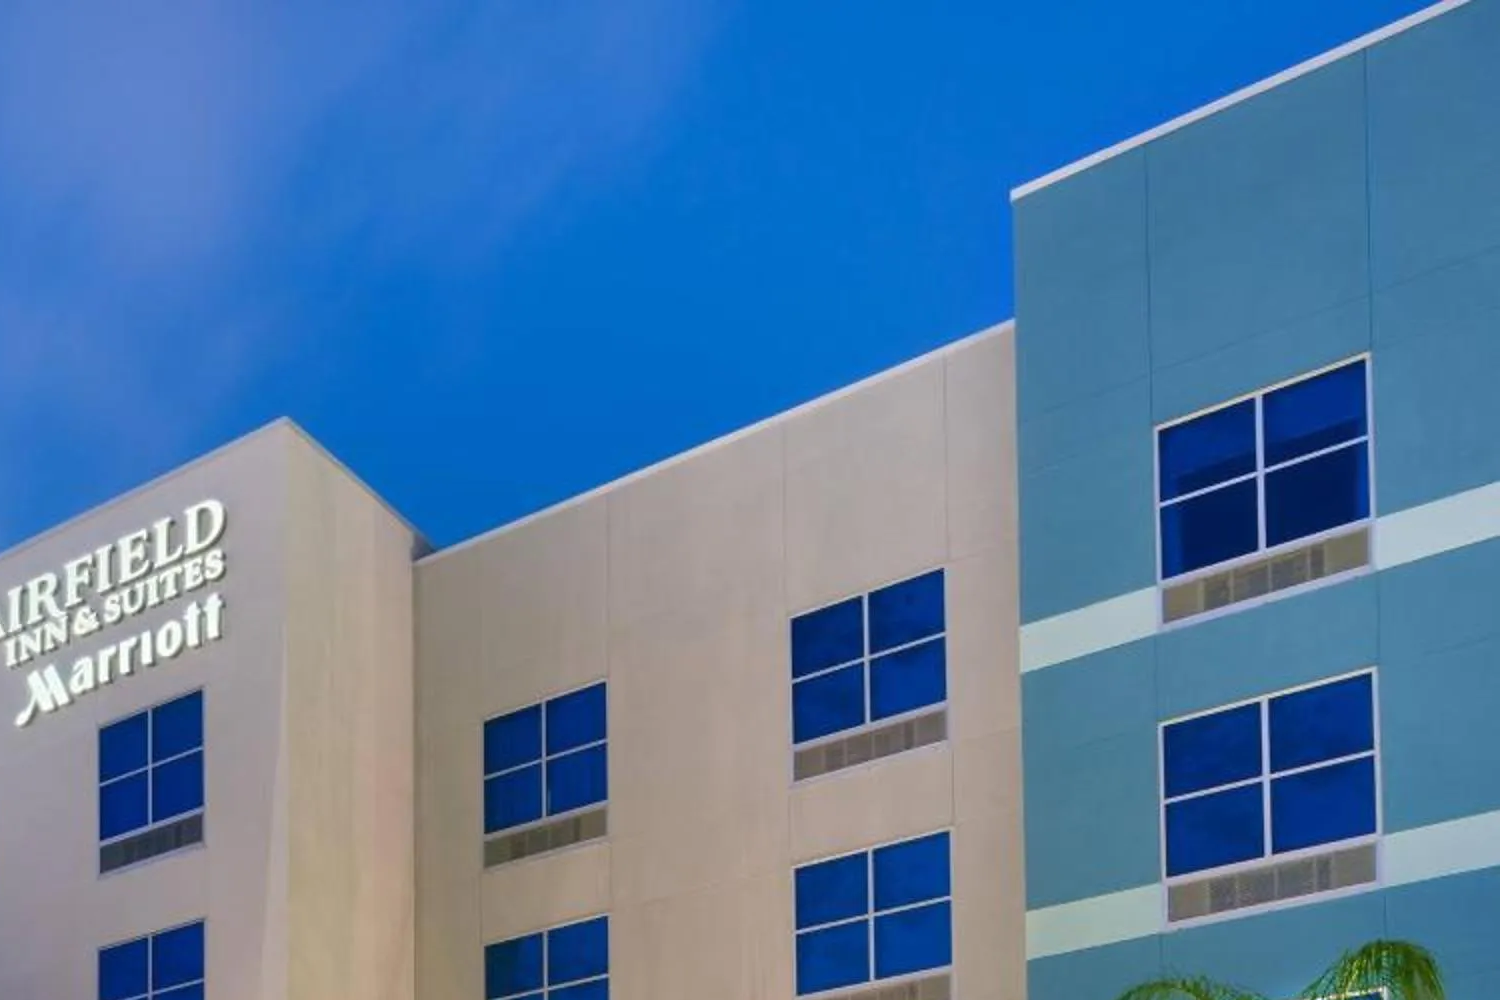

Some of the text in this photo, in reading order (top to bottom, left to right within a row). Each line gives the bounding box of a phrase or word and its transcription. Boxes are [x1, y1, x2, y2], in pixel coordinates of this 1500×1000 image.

[5, 549, 227, 667] INN & SUITES
[15, 592, 225, 727] Marriott
